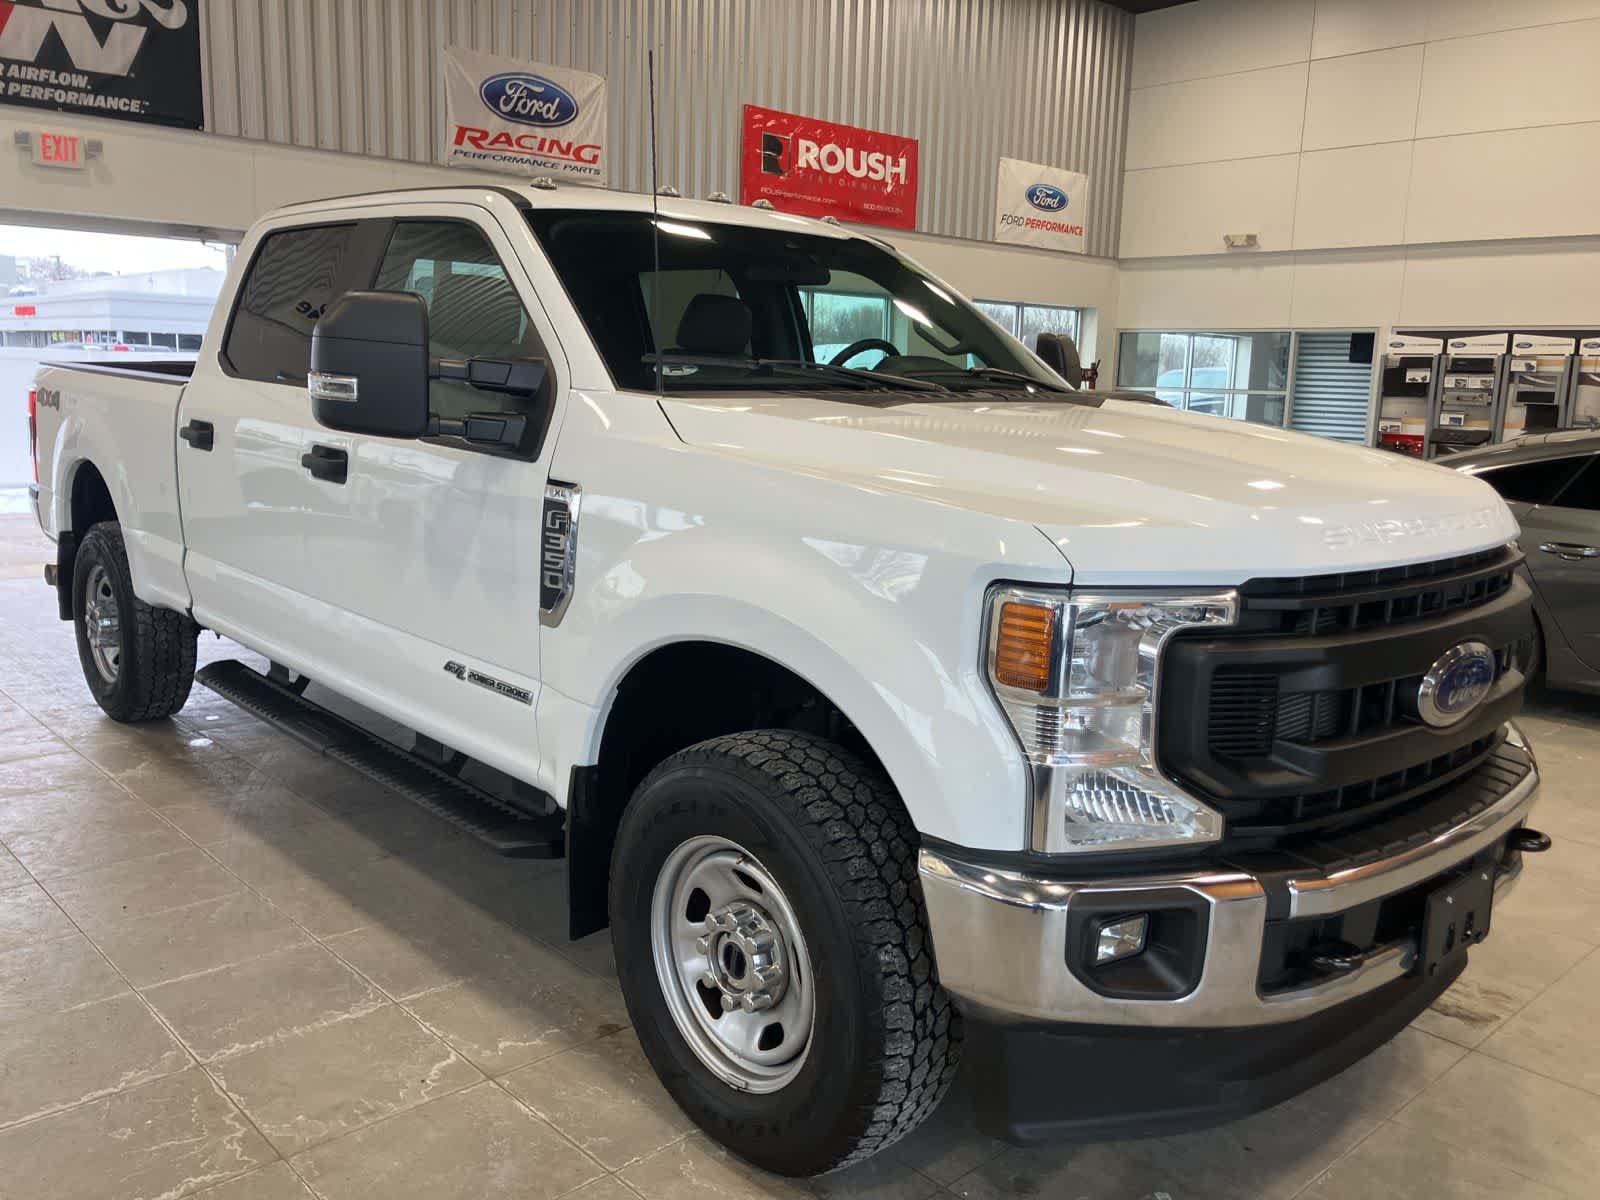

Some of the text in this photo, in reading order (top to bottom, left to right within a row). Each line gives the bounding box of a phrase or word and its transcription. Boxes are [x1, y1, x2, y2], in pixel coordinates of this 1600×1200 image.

[8, 64, 92, 89] AIRFLOW.
[499, 80, 561, 121] Ford
[40, 132, 79, 164] EXIT
[454, 125, 601, 164] RACING
[453, 149, 602, 176] PERFORMANCE PARTS
[797, 138, 908, 186] ROUSH
[1033, 187, 1060, 209] Ford
[1000, 214, 1084, 237] FORD PERFORMANCE
[496, 681, 530, 699] STROKE
